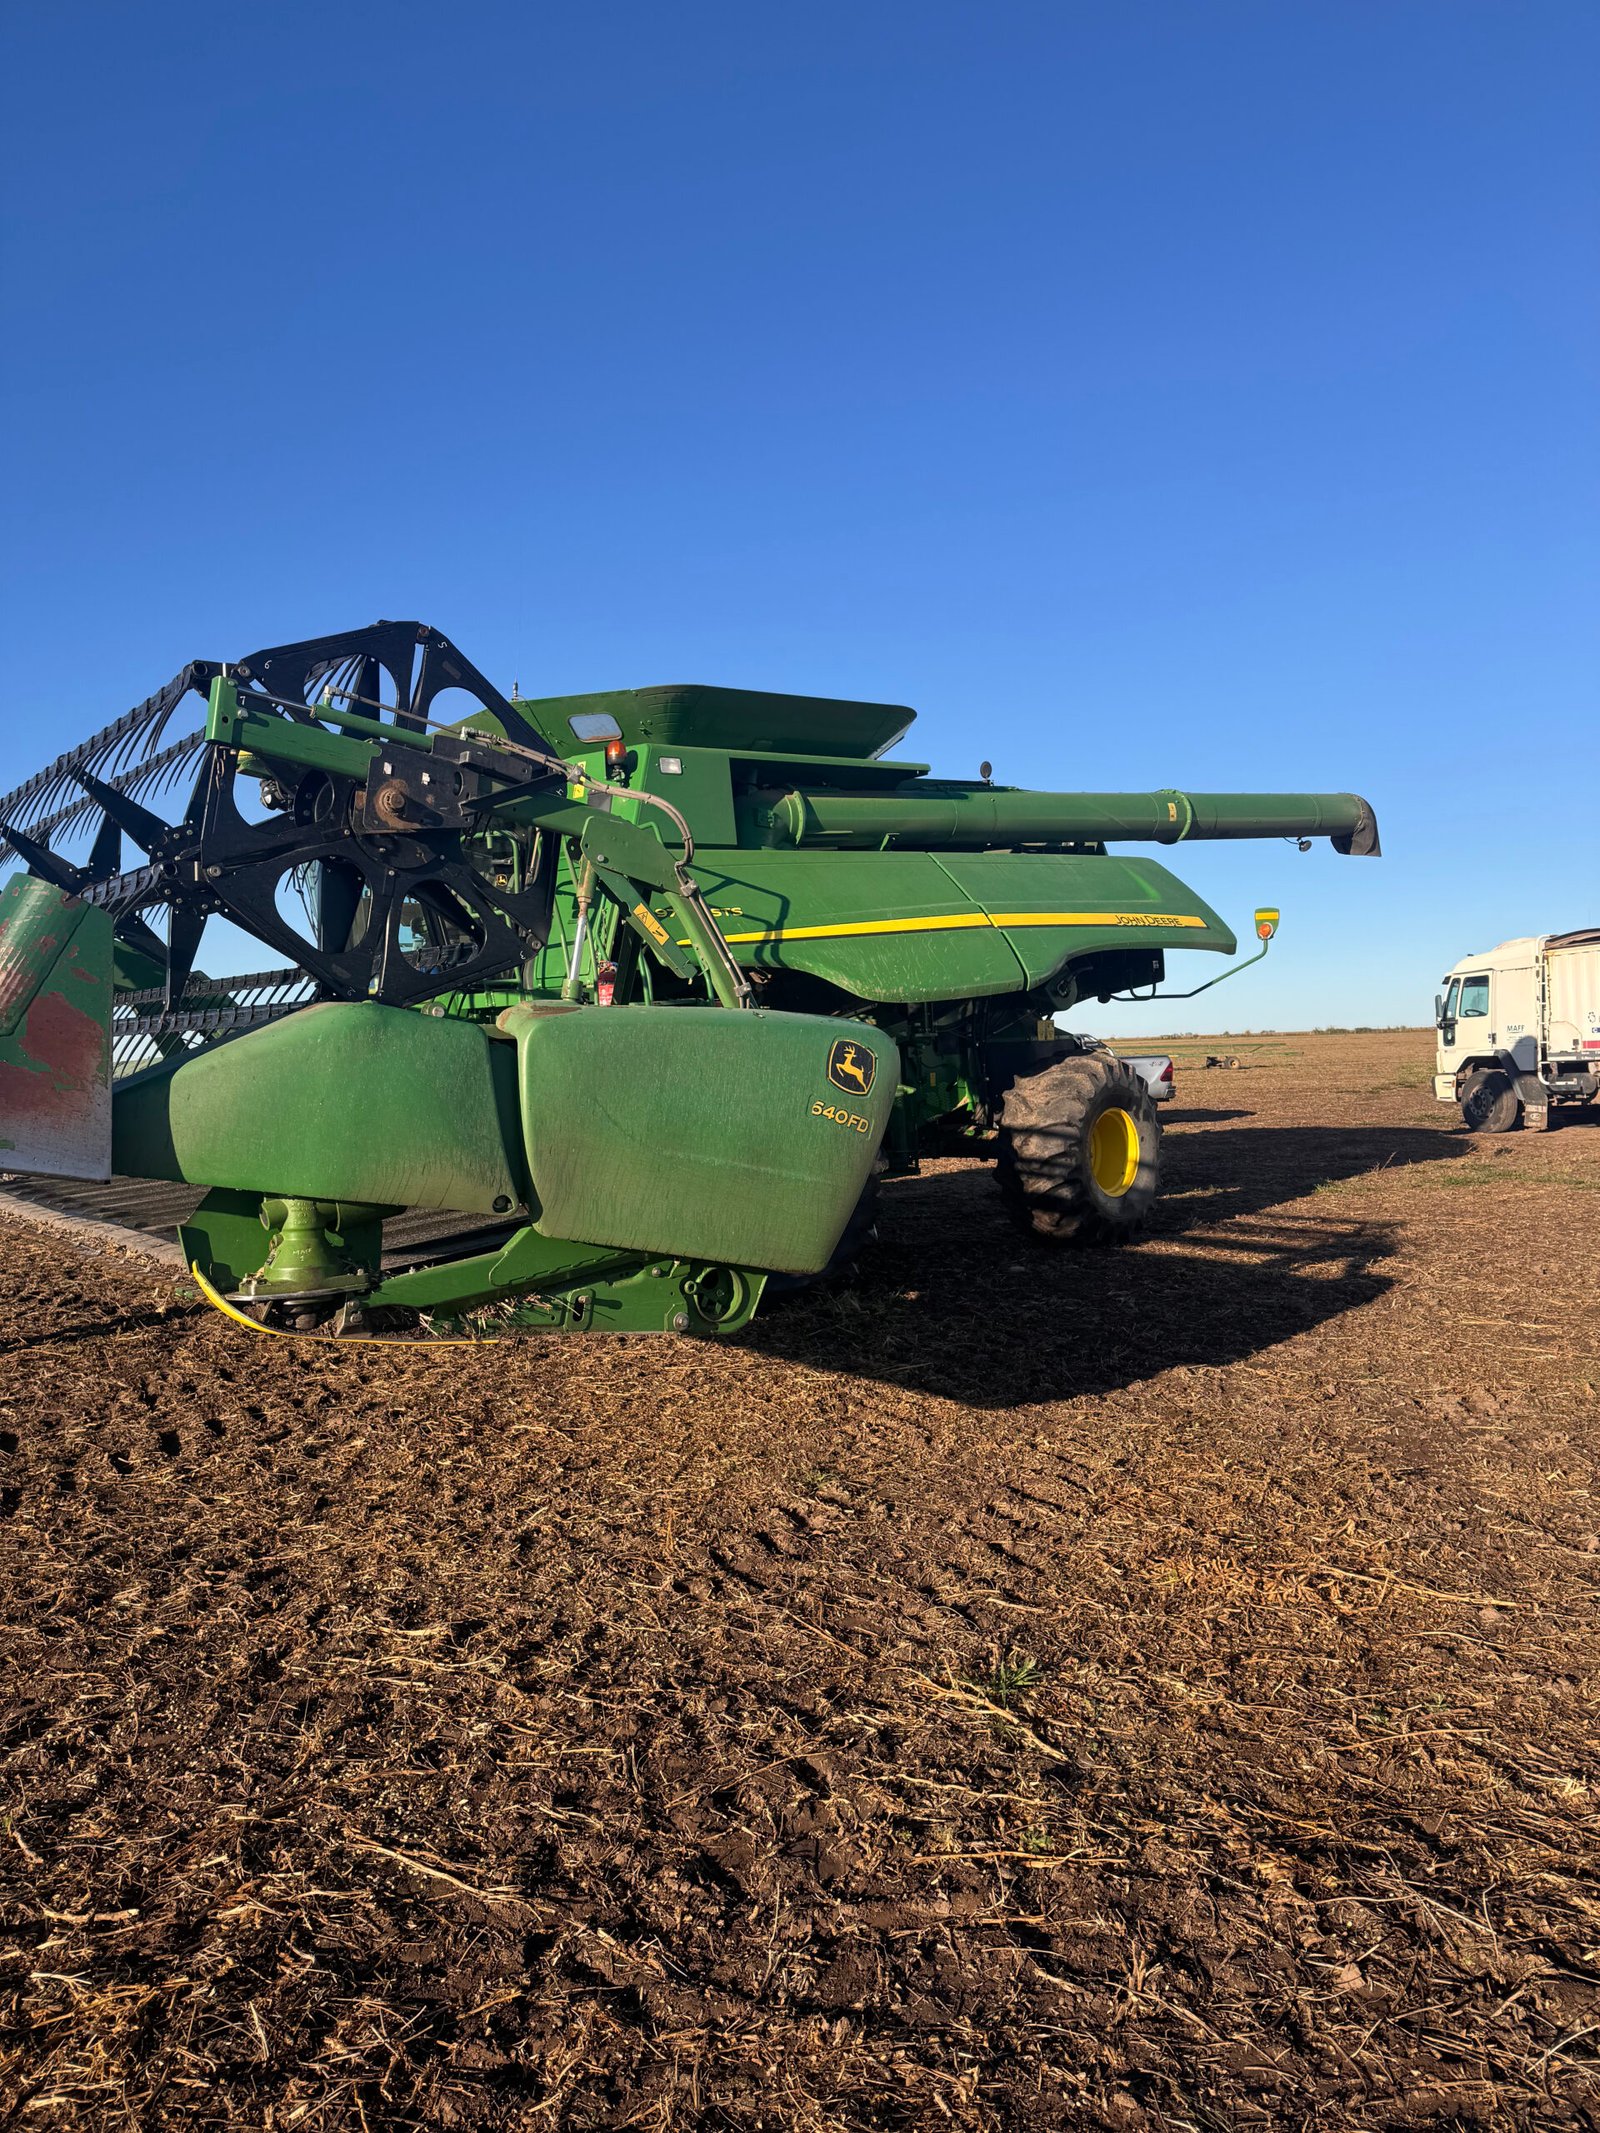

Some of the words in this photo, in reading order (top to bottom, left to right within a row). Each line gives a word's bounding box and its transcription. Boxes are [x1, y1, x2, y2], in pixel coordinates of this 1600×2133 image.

[264, 659, 272, 670] 6
[239, 695, 246, 706] 7
[710, 906, 744, 917] STS
[1115, 914, 1145, 925] JOHN
[1144, 915, 1183, 926] DEERE
[811, 1099, 870, 1133] 640FD
